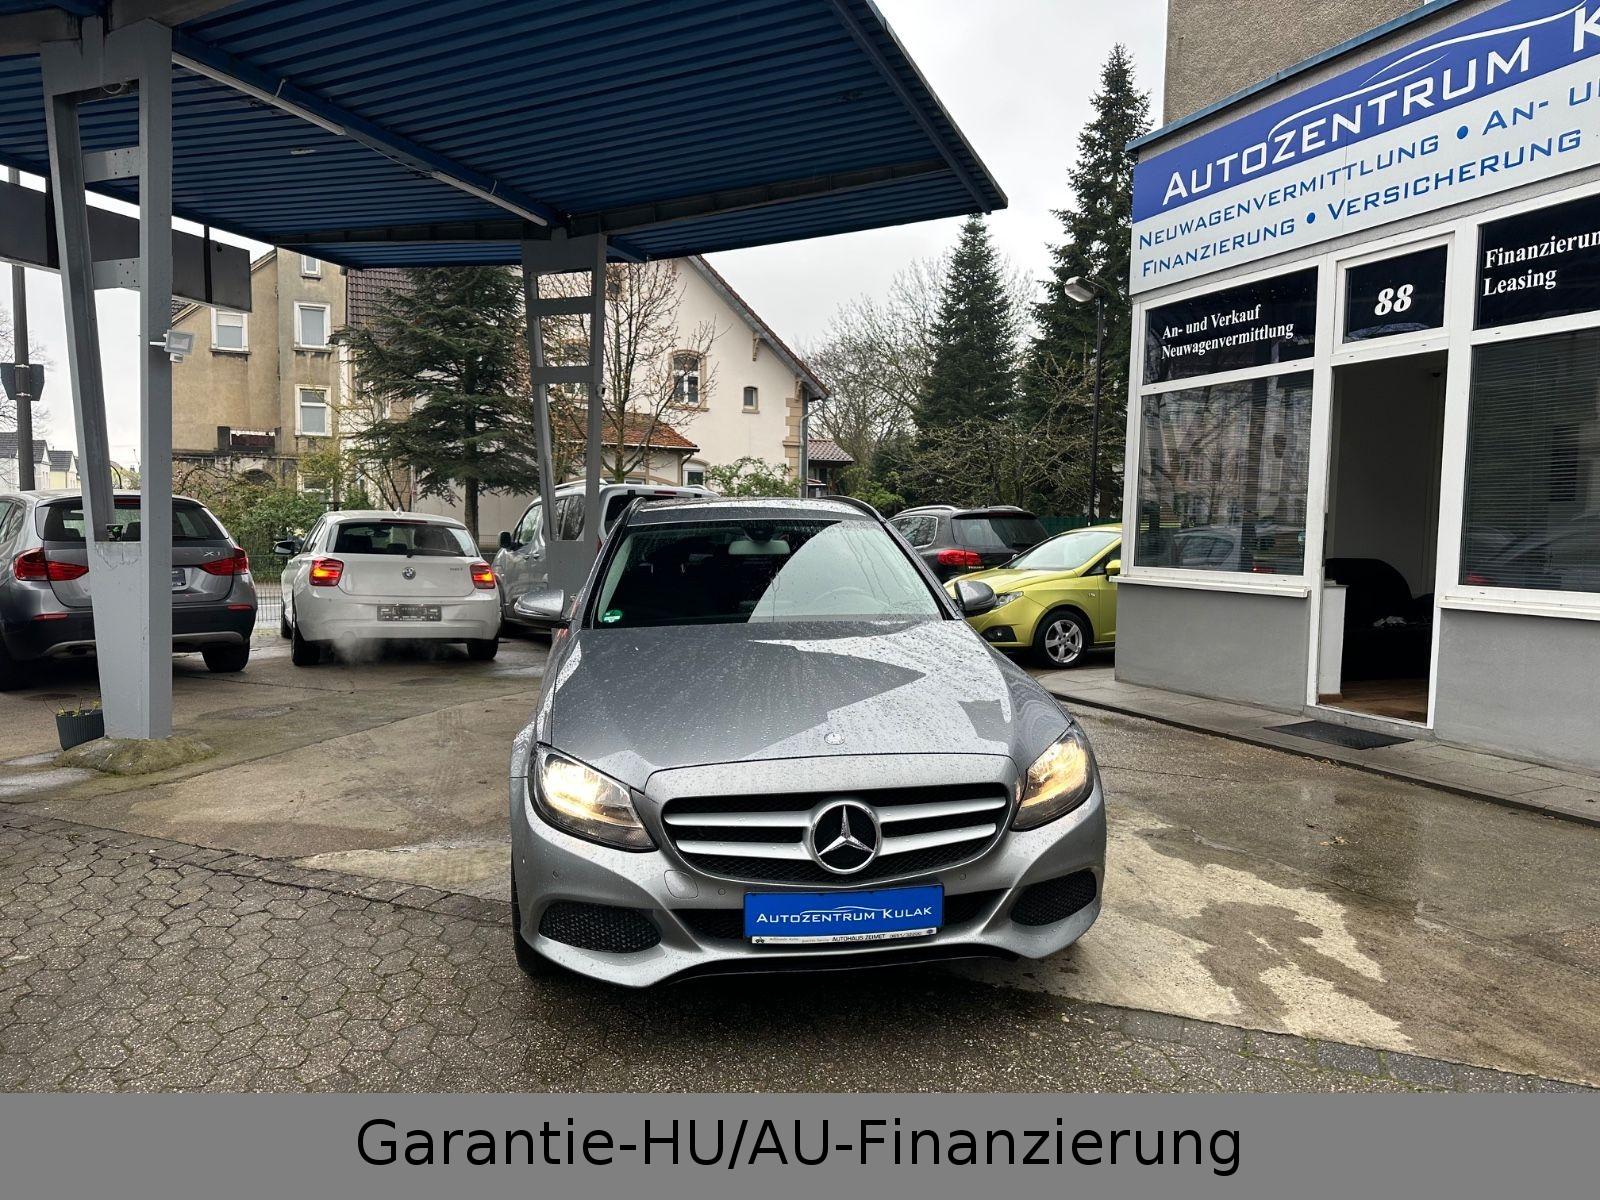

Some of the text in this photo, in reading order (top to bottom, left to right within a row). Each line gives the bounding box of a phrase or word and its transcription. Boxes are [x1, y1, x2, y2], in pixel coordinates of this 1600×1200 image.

[1163, 37, 1530, 205] AUTOZENTRUM
[1139, 135, 1439, 250] NEUWAGENVERMITTLUNG
[1482, 100, 1549, 136] AN-
[1142, 129, 1581, 278] FINANZIERUNG VERSICHERUNG
[1374, 284, 1414, 316] 88
[1483, 269, 1557, 296] Leasing
[1162, 304, 1261, 339] An- und Verkauf
[1161, 323, 1294, 359] Neuwagenvermittlung
[756, 906, 932, 923] AUTOZENTRUM KULAK
[832, 934, 864, 942] AUTOHAUS
